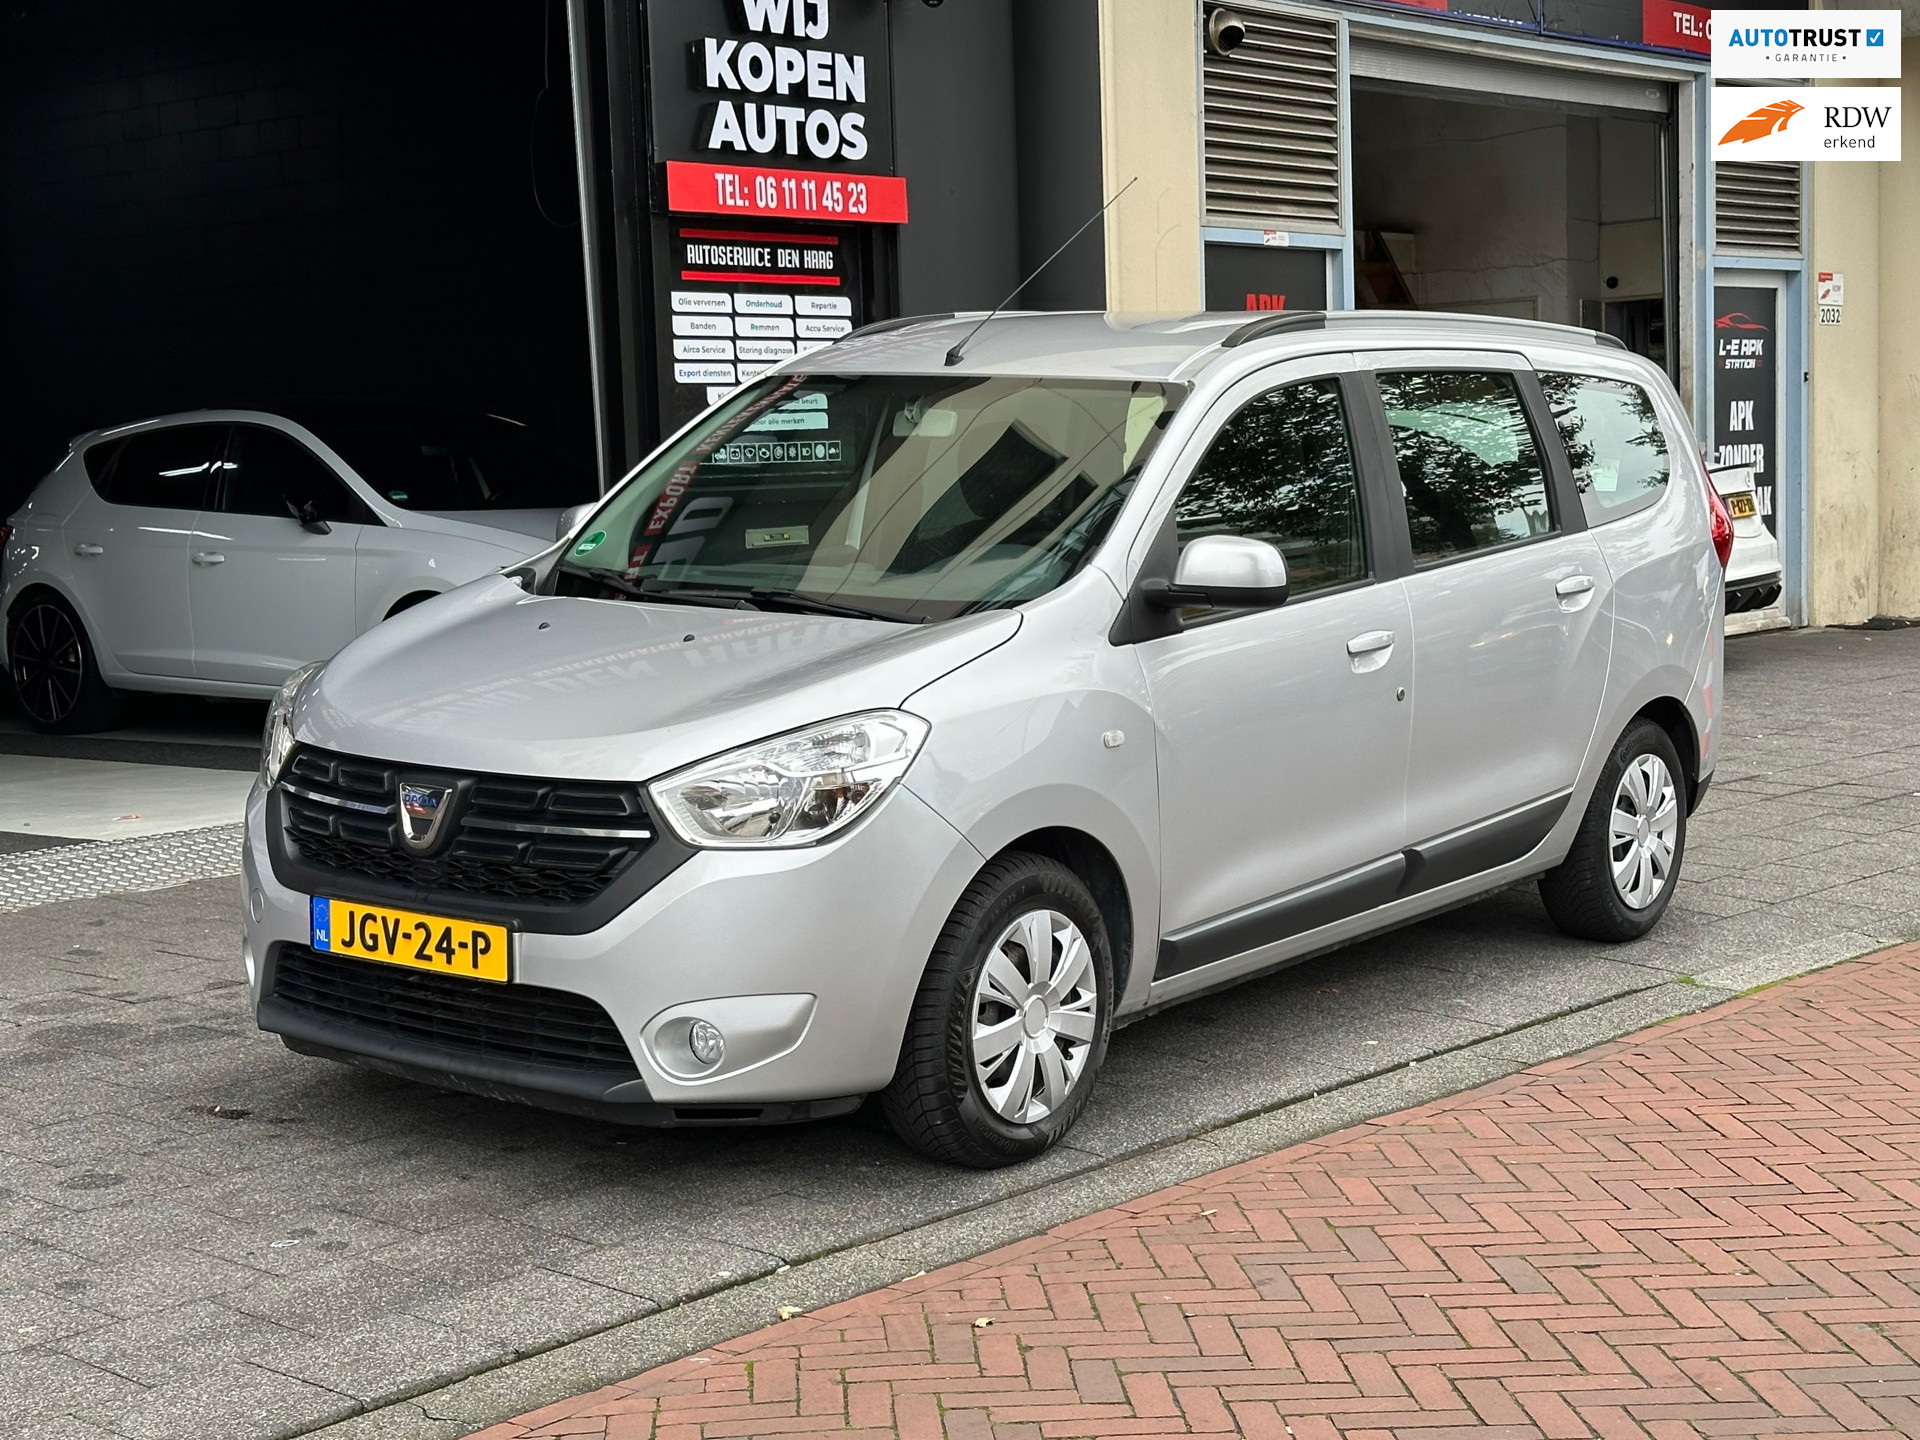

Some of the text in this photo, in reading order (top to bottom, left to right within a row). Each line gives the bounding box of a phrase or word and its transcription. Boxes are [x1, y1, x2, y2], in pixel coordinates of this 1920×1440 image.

[742, 0, 830, 39] WIJ
[1673, 12, 1703, 37] TEL:
[704, 37, 866, 103] KOPEN
[708, 100, 868, 160] AUTOS
[714, 172, 867, 214] TEL: 06 11 11 45 23
[686, 244, 834, 270] AUTOSERVICE DEN HAAG
[678, 297, 726, 307] Olie verversen
[745, 299, 783, 308] Onderhoud
[811, 302, 838, 311] Repartie
[1821, 308, 1840, 323] 2032
[690, 322, 717, 330] Banden
[750, 323, 779, 331] Remmen
[805, 324, 821, 332] Accu
[683, 345, 726, 354] Airco Service
[738, 346, 762, 355] Storing
[763, 347, 793, 355] diagnose
[1719, 339, 1764, 355] L-E APK
[1725, 359, 1756, 369] STATION
[679, 369, 732, 378] Export diensten
[781, 417, 805, 425] merken
[1729, 400, 1754, 431] APK
[1718, 444, 1764, 473] ZONDER
[316, 928, 329, 942] NL
[340, 910, 491, 970] JGV-24-P
